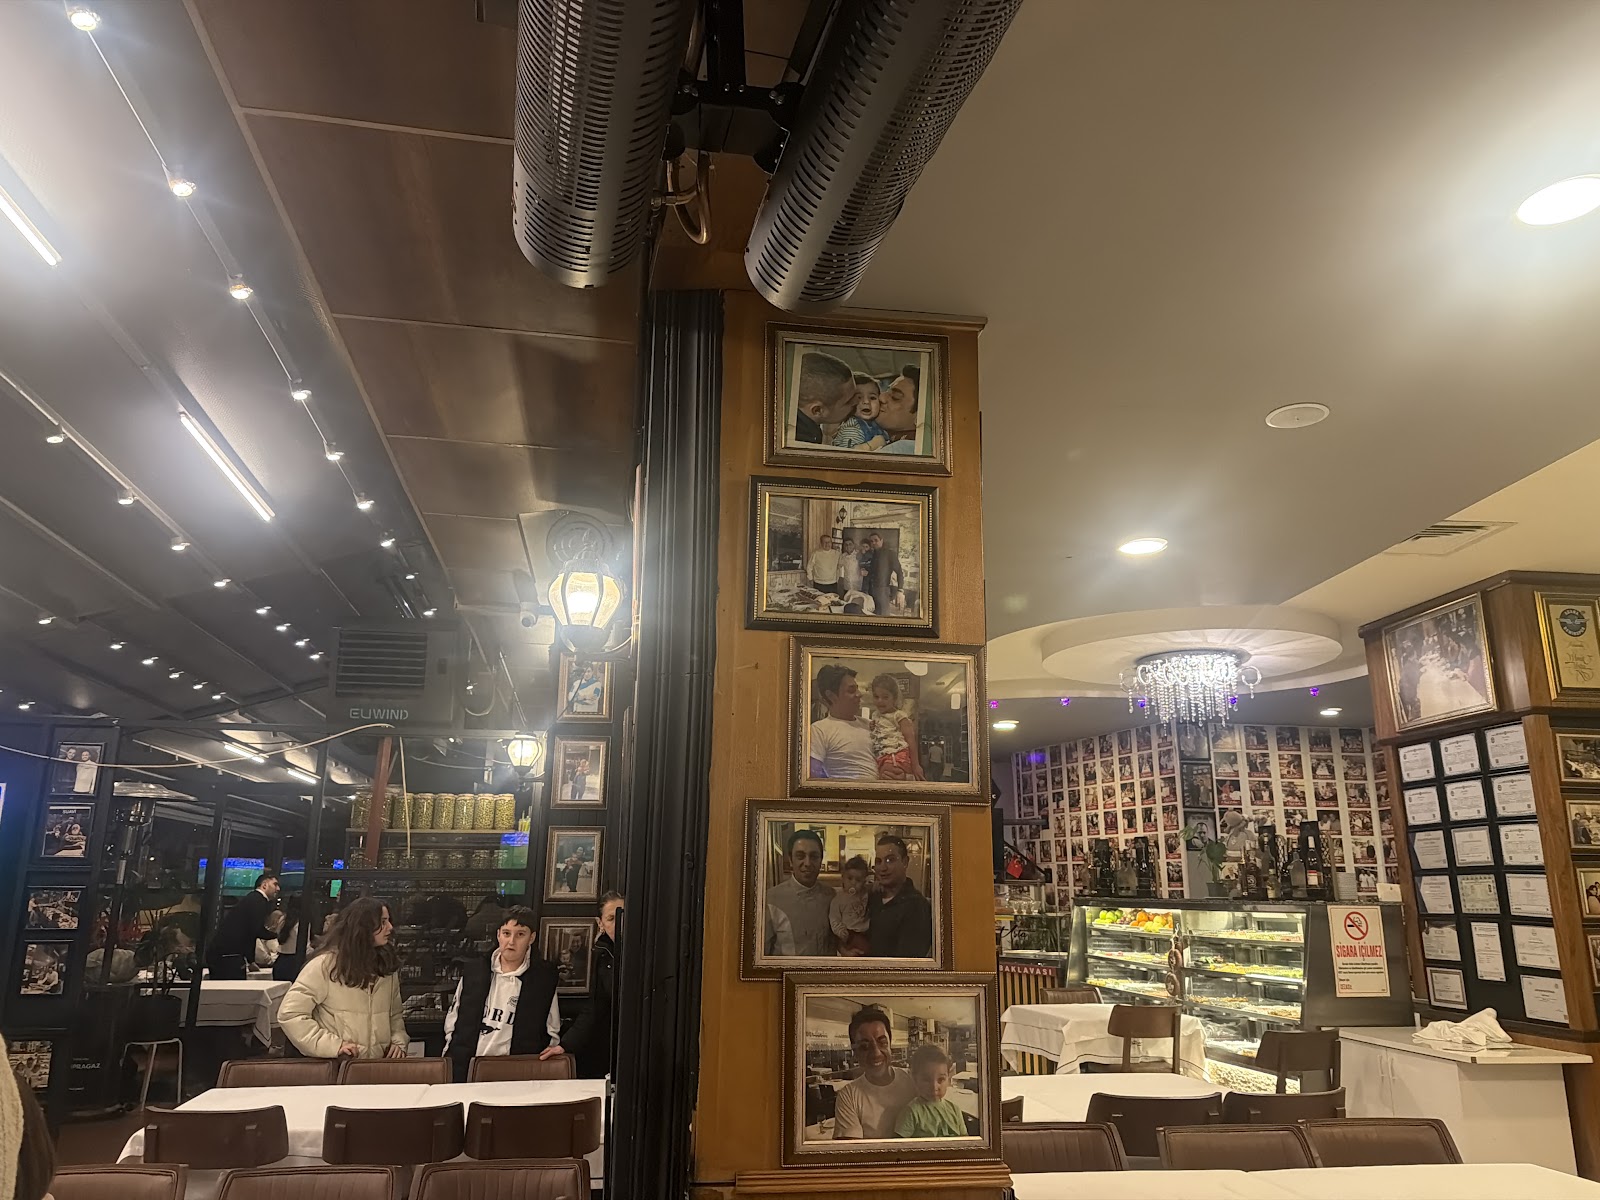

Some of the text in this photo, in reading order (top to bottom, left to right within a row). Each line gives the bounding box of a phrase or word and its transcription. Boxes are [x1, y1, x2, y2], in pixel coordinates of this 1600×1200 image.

[1336, 941, 1382, 961] SİGARA İÇİLMEZ
[999, 965, 1052, 975] BAKLAVASI
